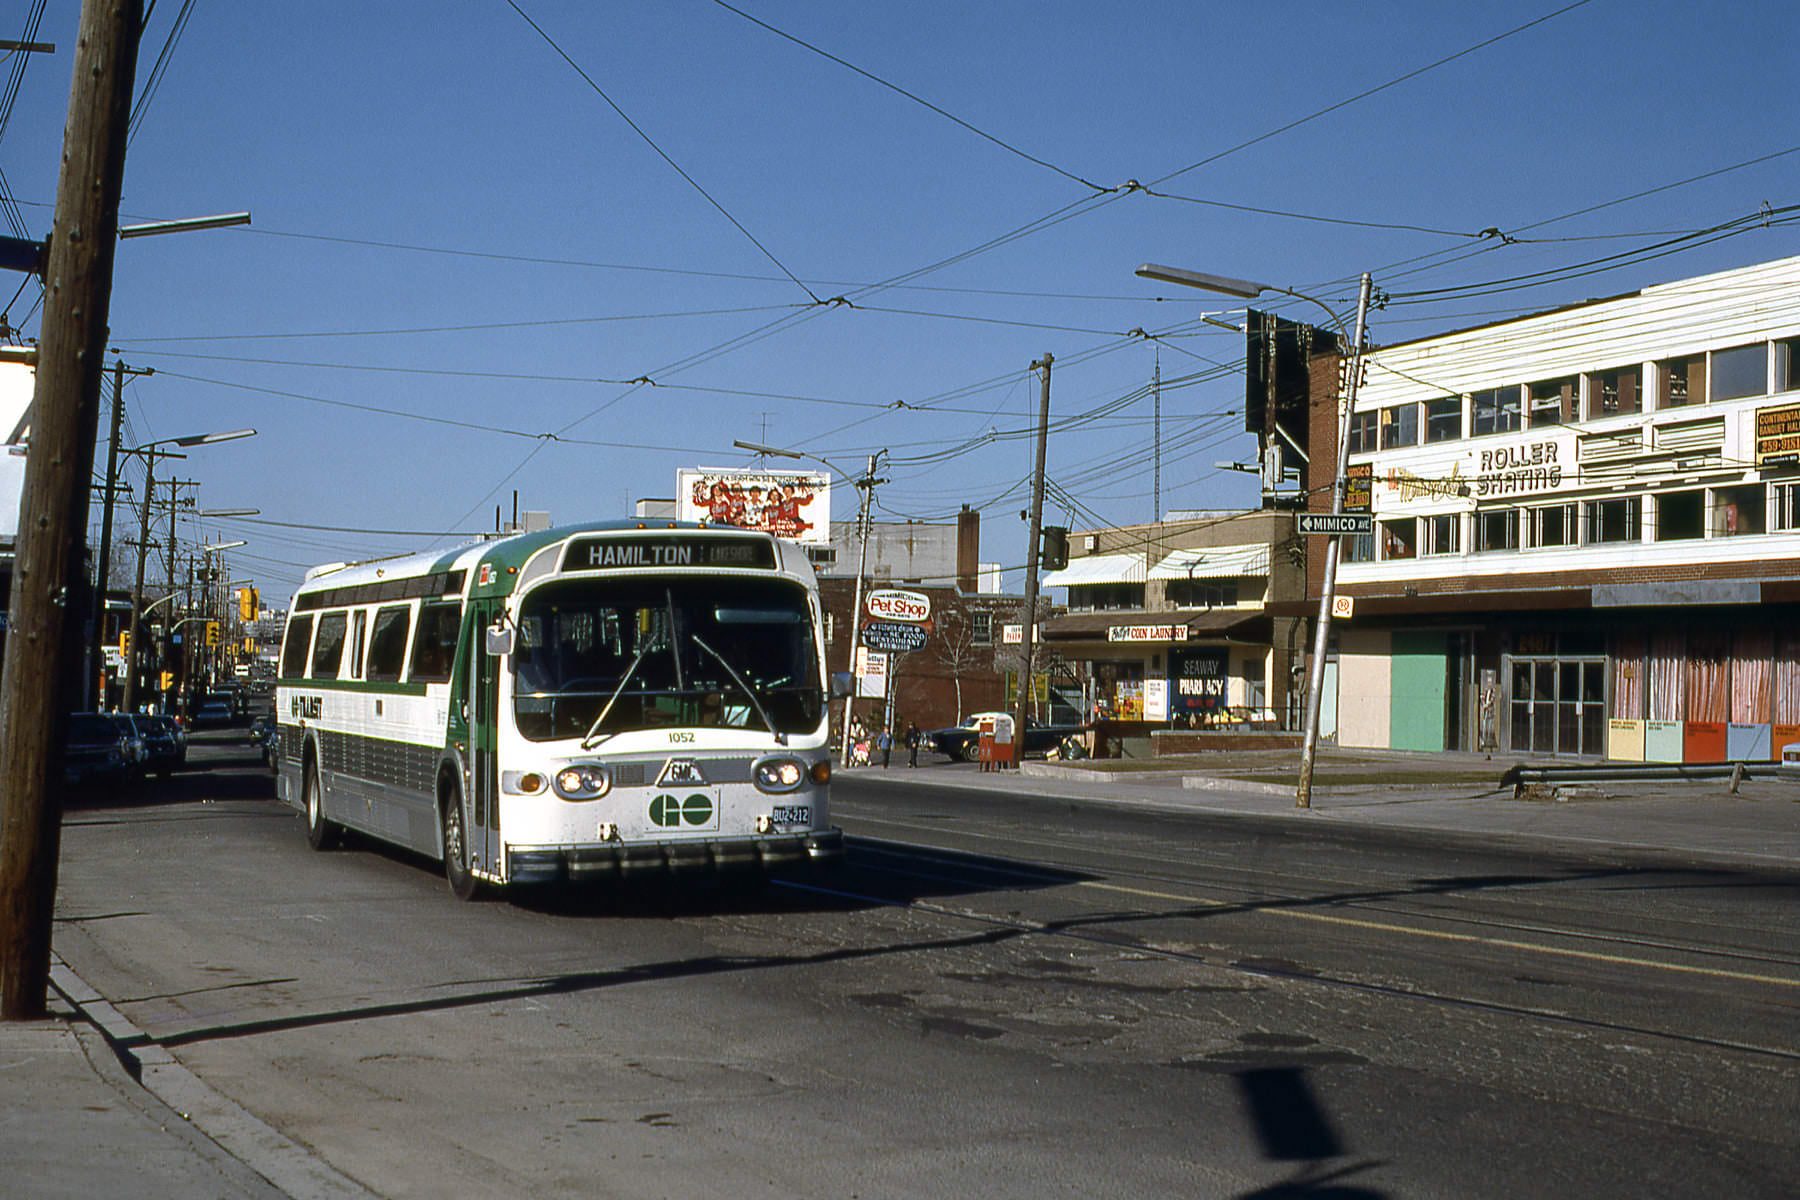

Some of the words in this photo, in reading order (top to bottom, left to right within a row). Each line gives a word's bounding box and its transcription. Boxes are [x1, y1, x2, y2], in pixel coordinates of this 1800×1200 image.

[1760, 410, 1800, 425] CONTINENTA
[1481, 442, 1558, 472] ROLLER
[1477, 465, 1561, 496] SKATING
[1314, 517, 1356, 530] MIMICO
[589, 545, 691, 565] HAMILTON
[886, 592, 913, 600] MIMICO
[871, 598, 891, 612] Pet
[894, 599, 926, 618] Shop
[1131, 627, 1147, 639] COIN
[1150, 626, 1186, 639] LAUNRY
[1184, 660, 1219, 675] SEAWAY
[668, 732, 695, 743] 1052
[671, 764, 695, 782] GMC
